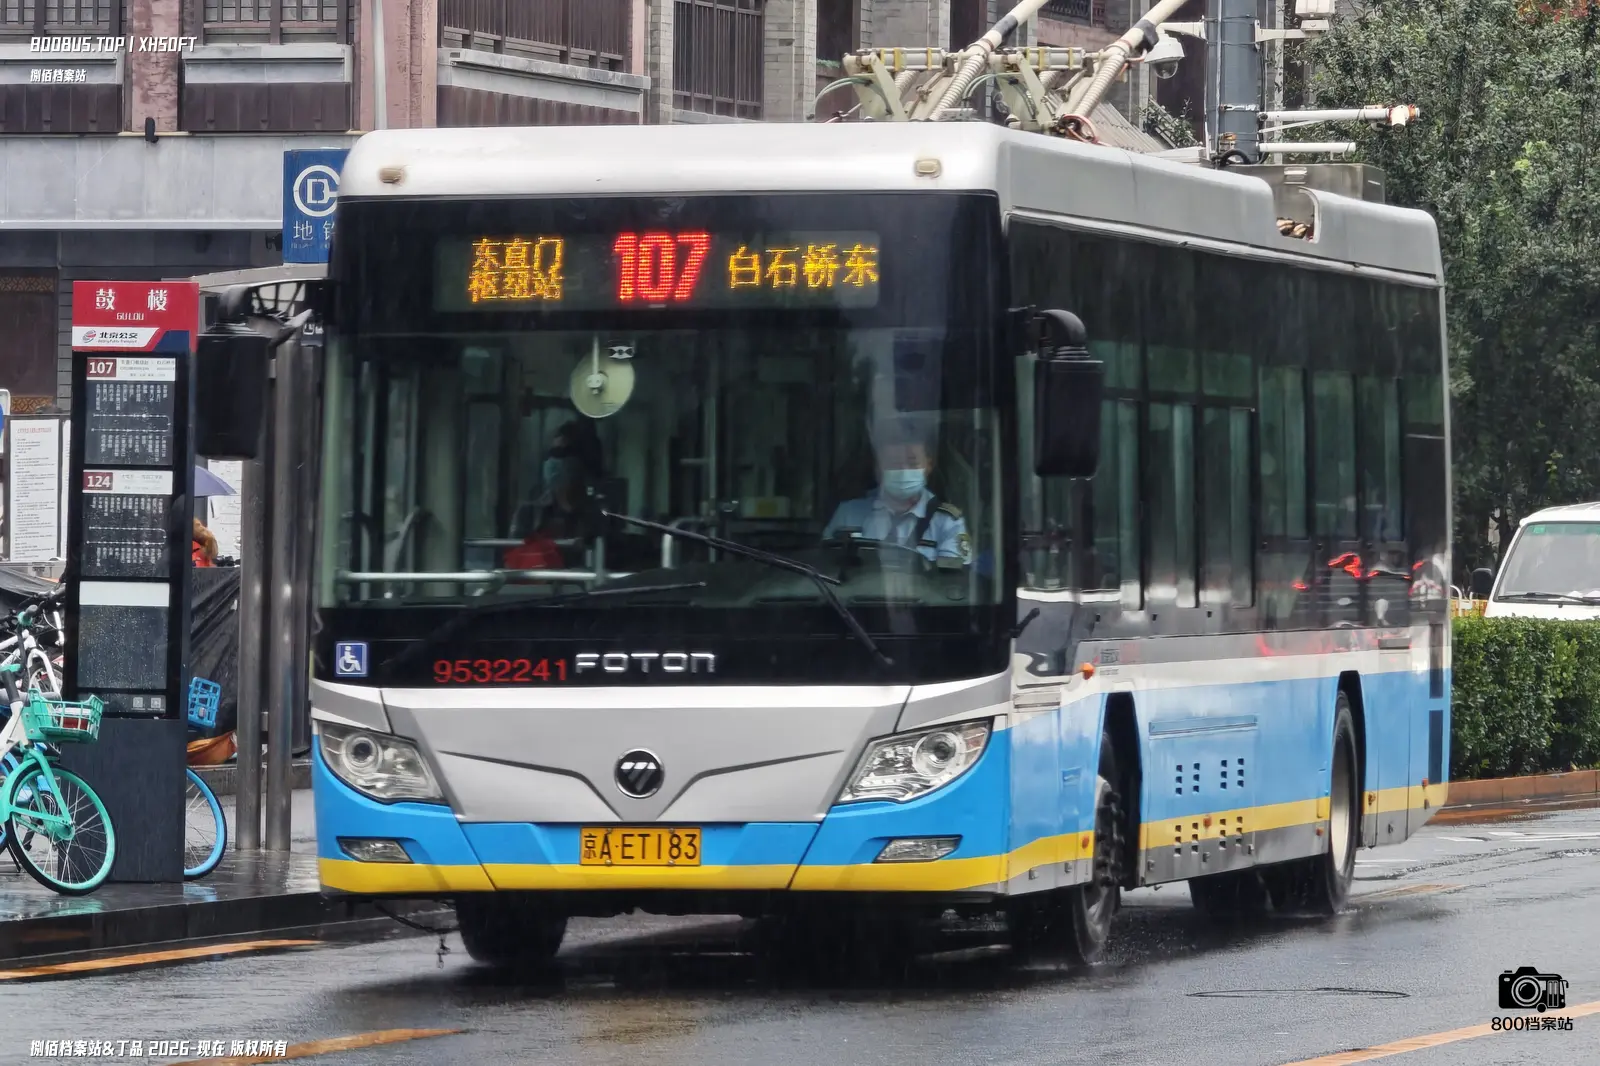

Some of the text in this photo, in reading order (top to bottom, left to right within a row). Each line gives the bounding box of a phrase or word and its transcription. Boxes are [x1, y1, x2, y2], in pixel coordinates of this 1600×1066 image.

[472, 237, 564, 272] 东直门
[612, 231, 711, 301] 107
[729, 243, 879, 288] 白石桥东
[467, 270, 564, 302] 枢纽站
[95, 288, 168, 311] 鼓楼
[116, 312, 144, 321] GULOU
[99, 331, 138, 339] 北京公交
[89, 361, 114, 374] 107
[87, 475, 111, 488] 124
[433, 658, 567, 683] 9532241
[575, 652, 716, 674] FOTON
